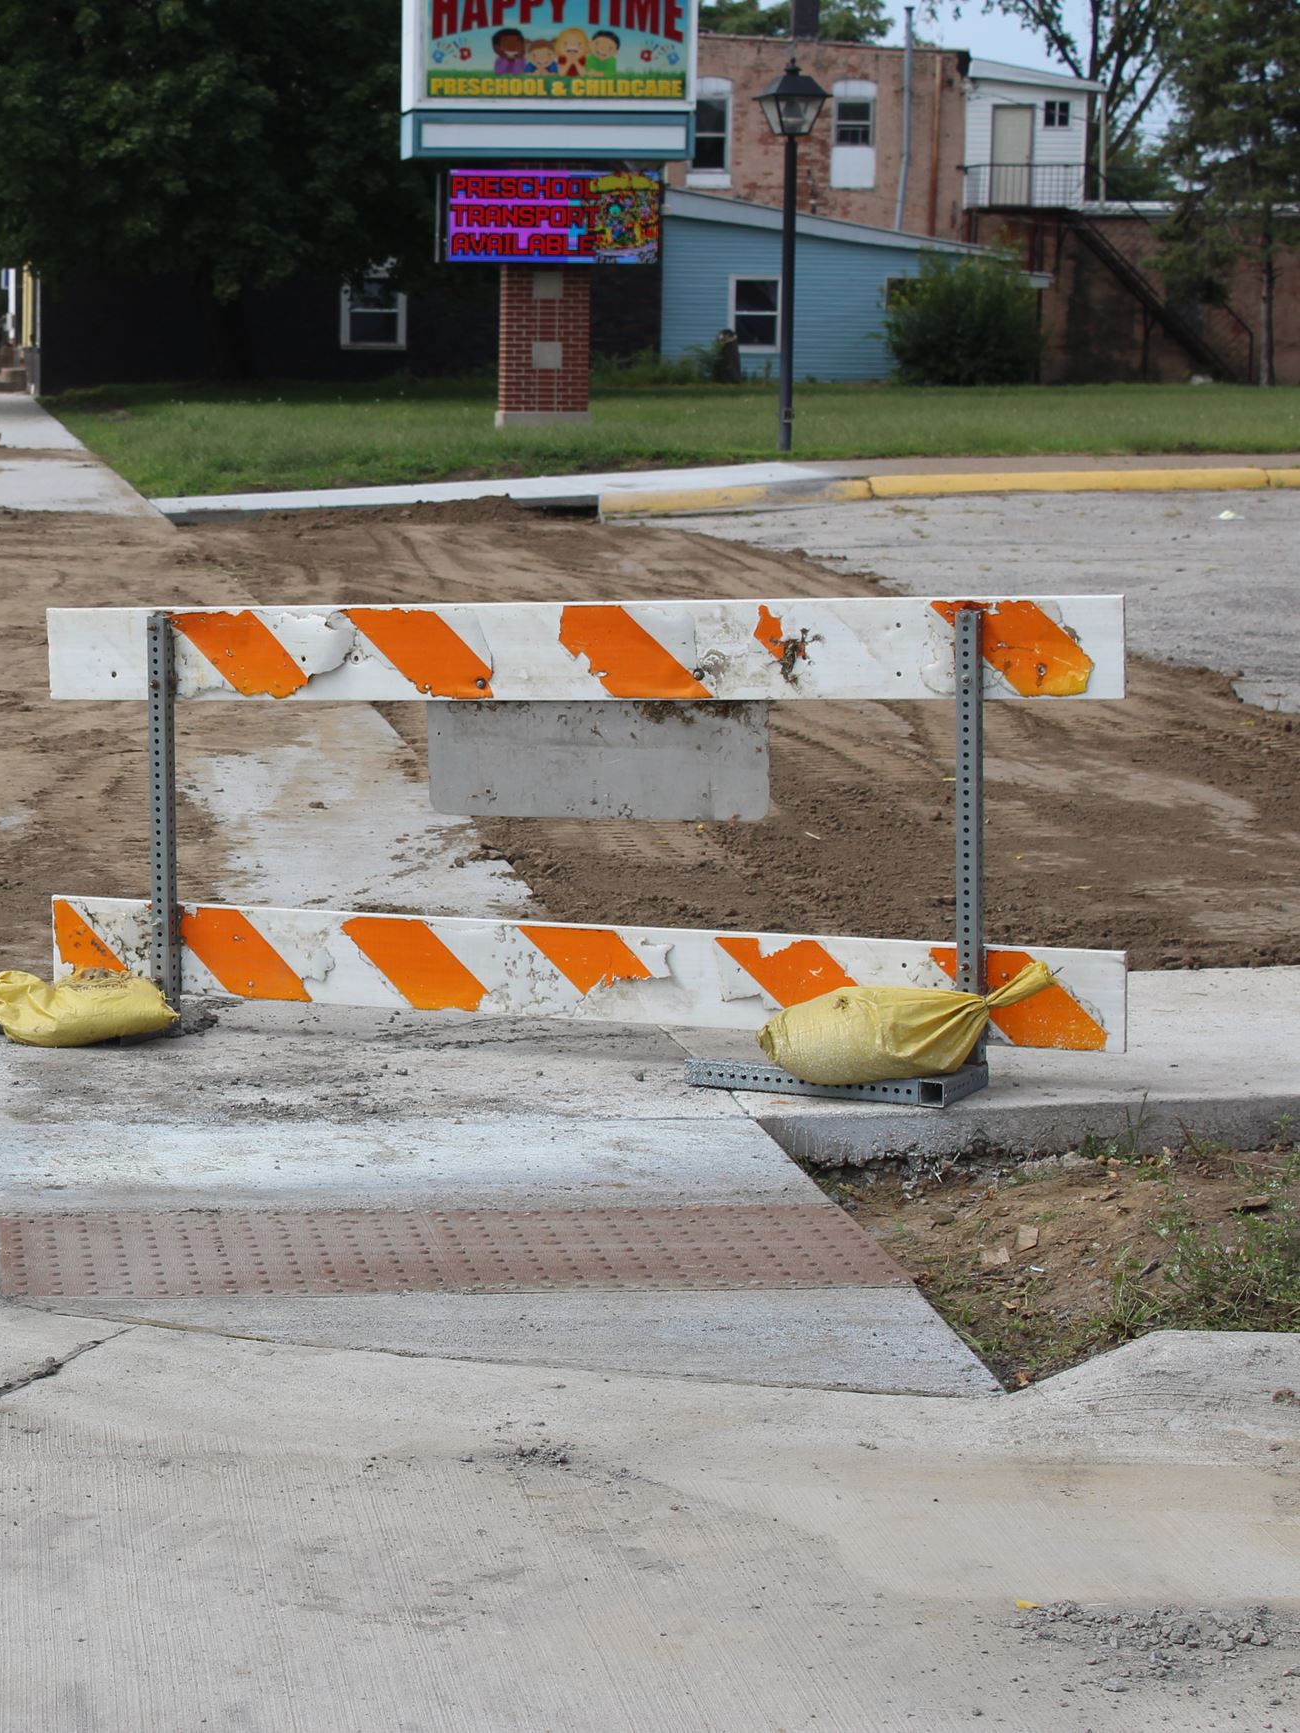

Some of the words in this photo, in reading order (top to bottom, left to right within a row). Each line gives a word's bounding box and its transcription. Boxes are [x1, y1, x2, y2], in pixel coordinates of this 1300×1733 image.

[430, 78, 548, 97] PRESCHOOL
[551, 81, 567, 96] &
[571, 79, 683, 97] CHILDCARE
[451, 176, 600, 199] PRESCHOOL
[451, 205, 600, 228] TRANSPORT
[451, 233, 598, 256] AVAILABLE
